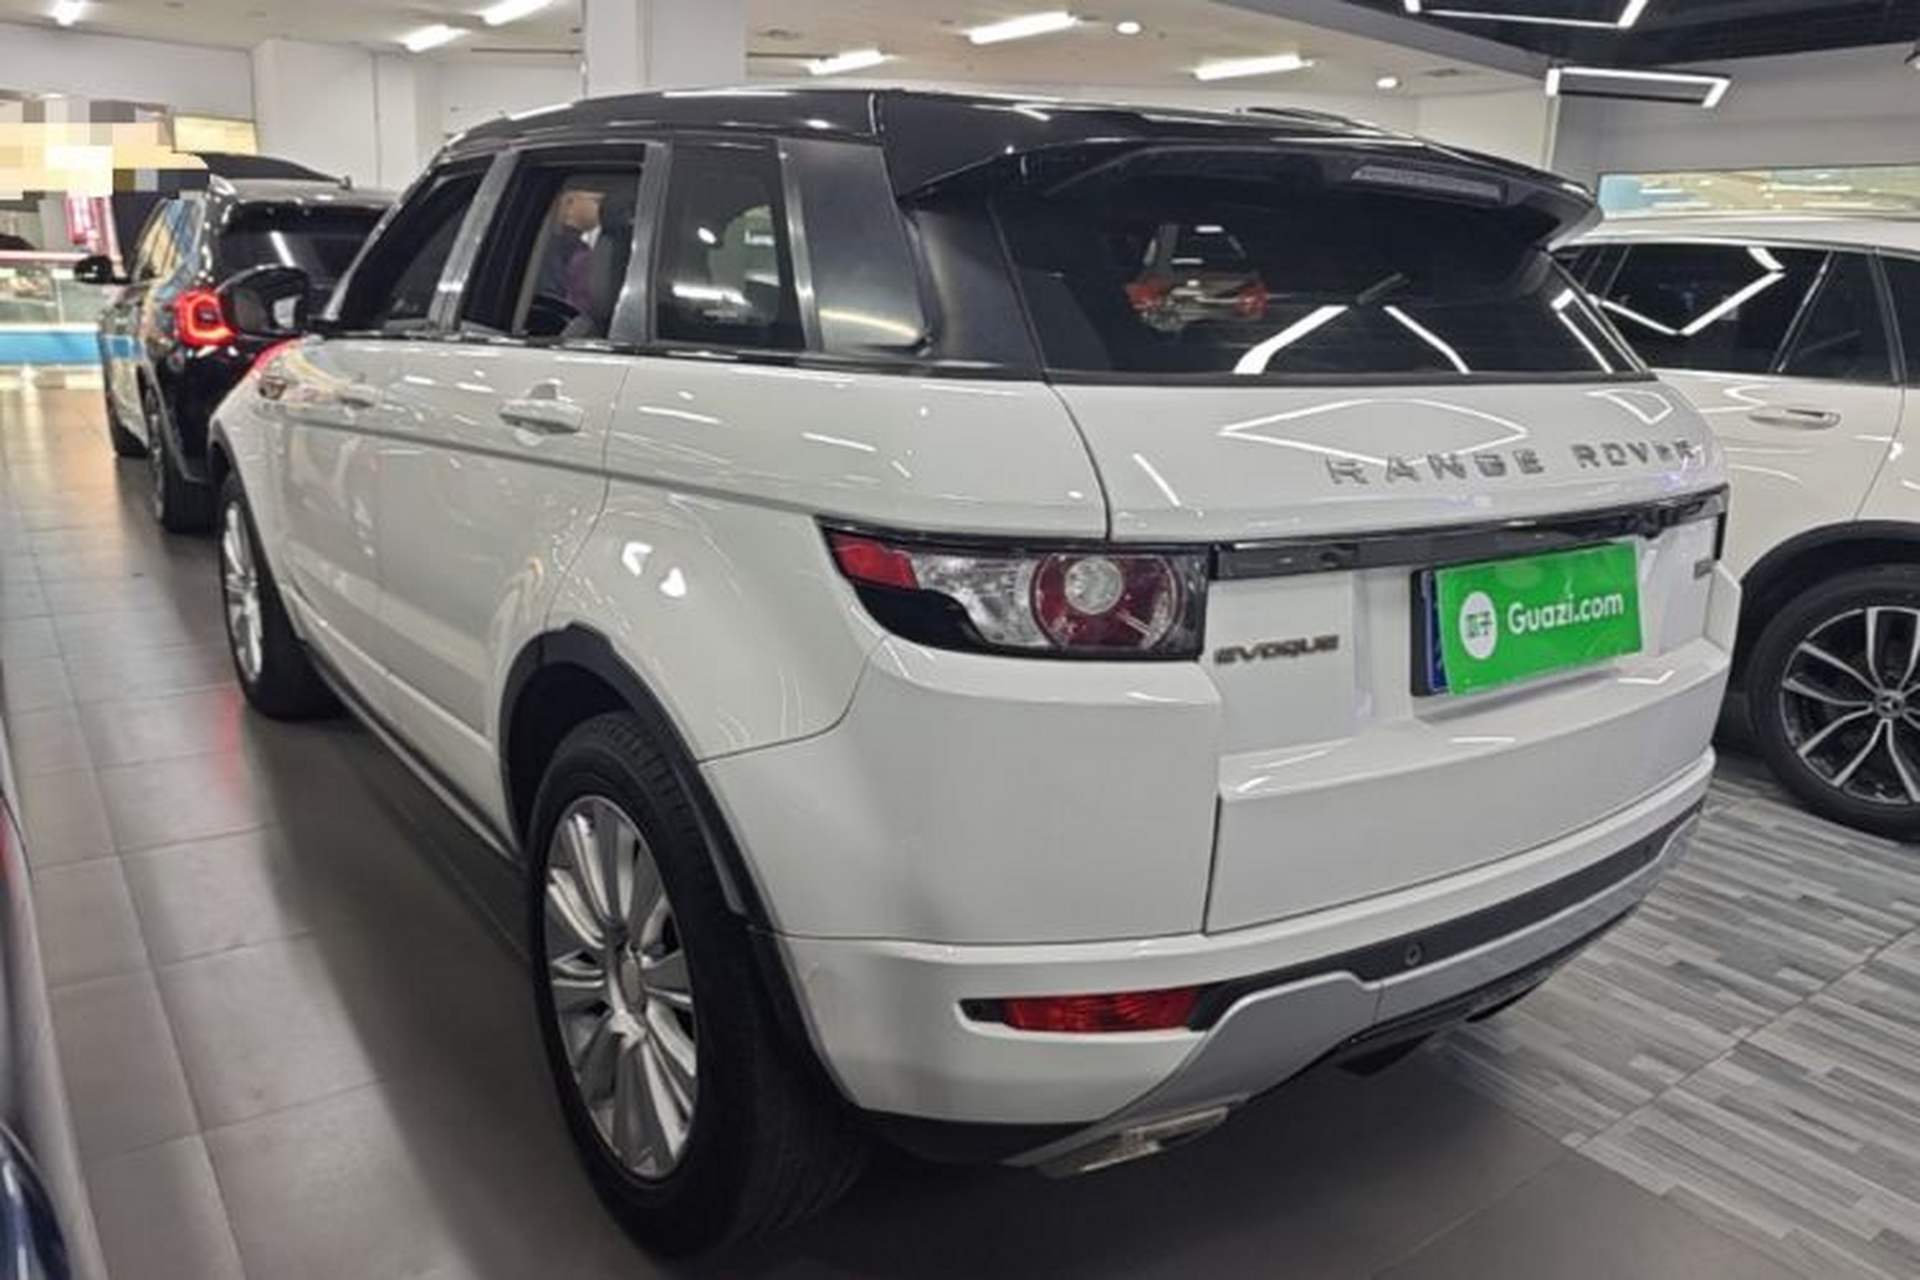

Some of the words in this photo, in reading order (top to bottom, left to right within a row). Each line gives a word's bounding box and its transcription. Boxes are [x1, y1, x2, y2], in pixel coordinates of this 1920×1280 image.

[1325, 449, 1545, 485] RANGE
[1507, 593, 1625, 635] Guazi.com
[1213, 634, 1339, 664] EVOQUE
